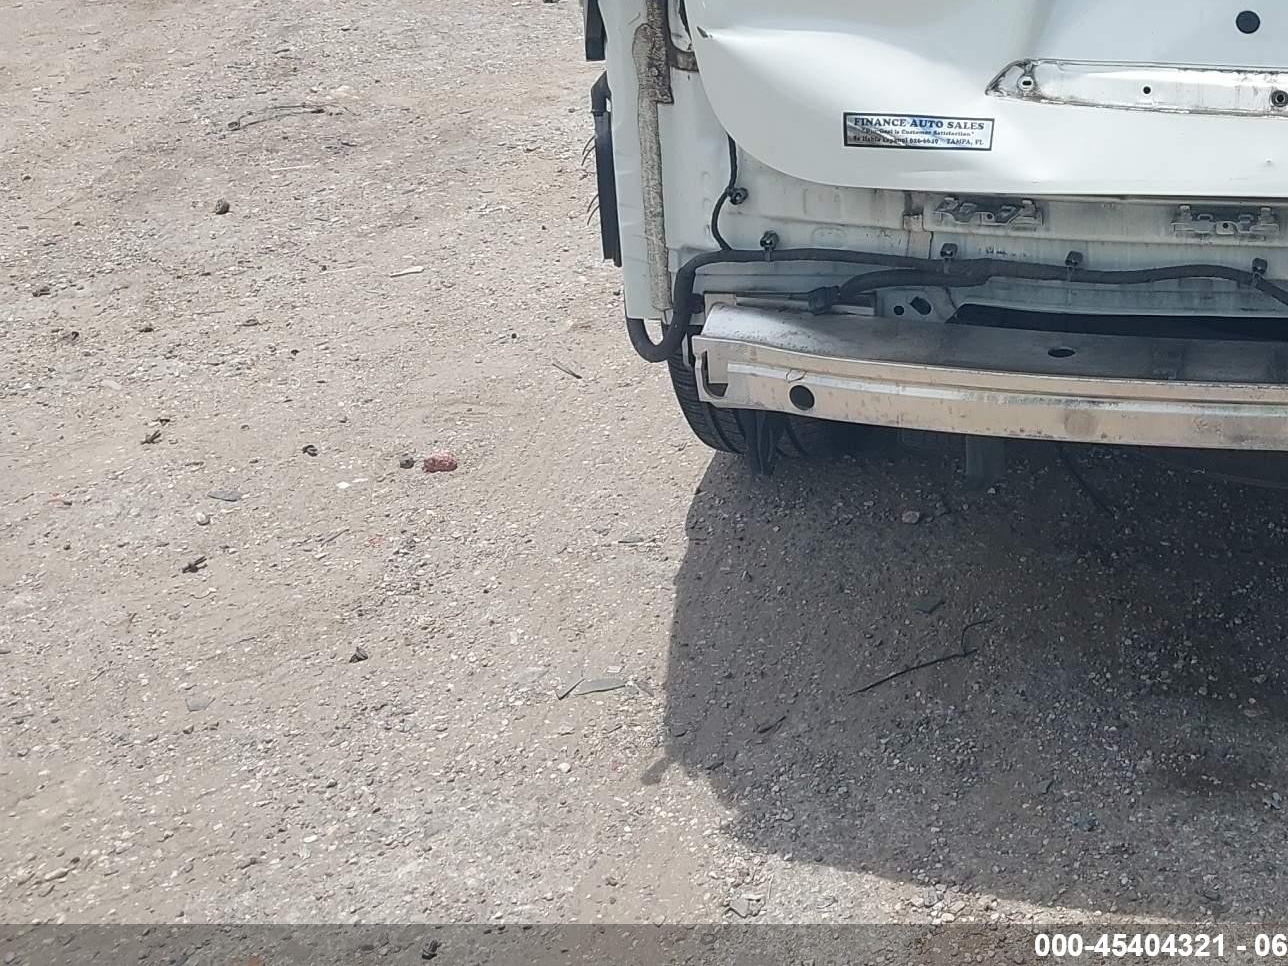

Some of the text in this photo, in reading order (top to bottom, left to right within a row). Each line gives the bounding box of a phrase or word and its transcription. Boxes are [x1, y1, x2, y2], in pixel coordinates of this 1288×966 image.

[854, 117, 985, 131] FINANCE AUTO SALES
